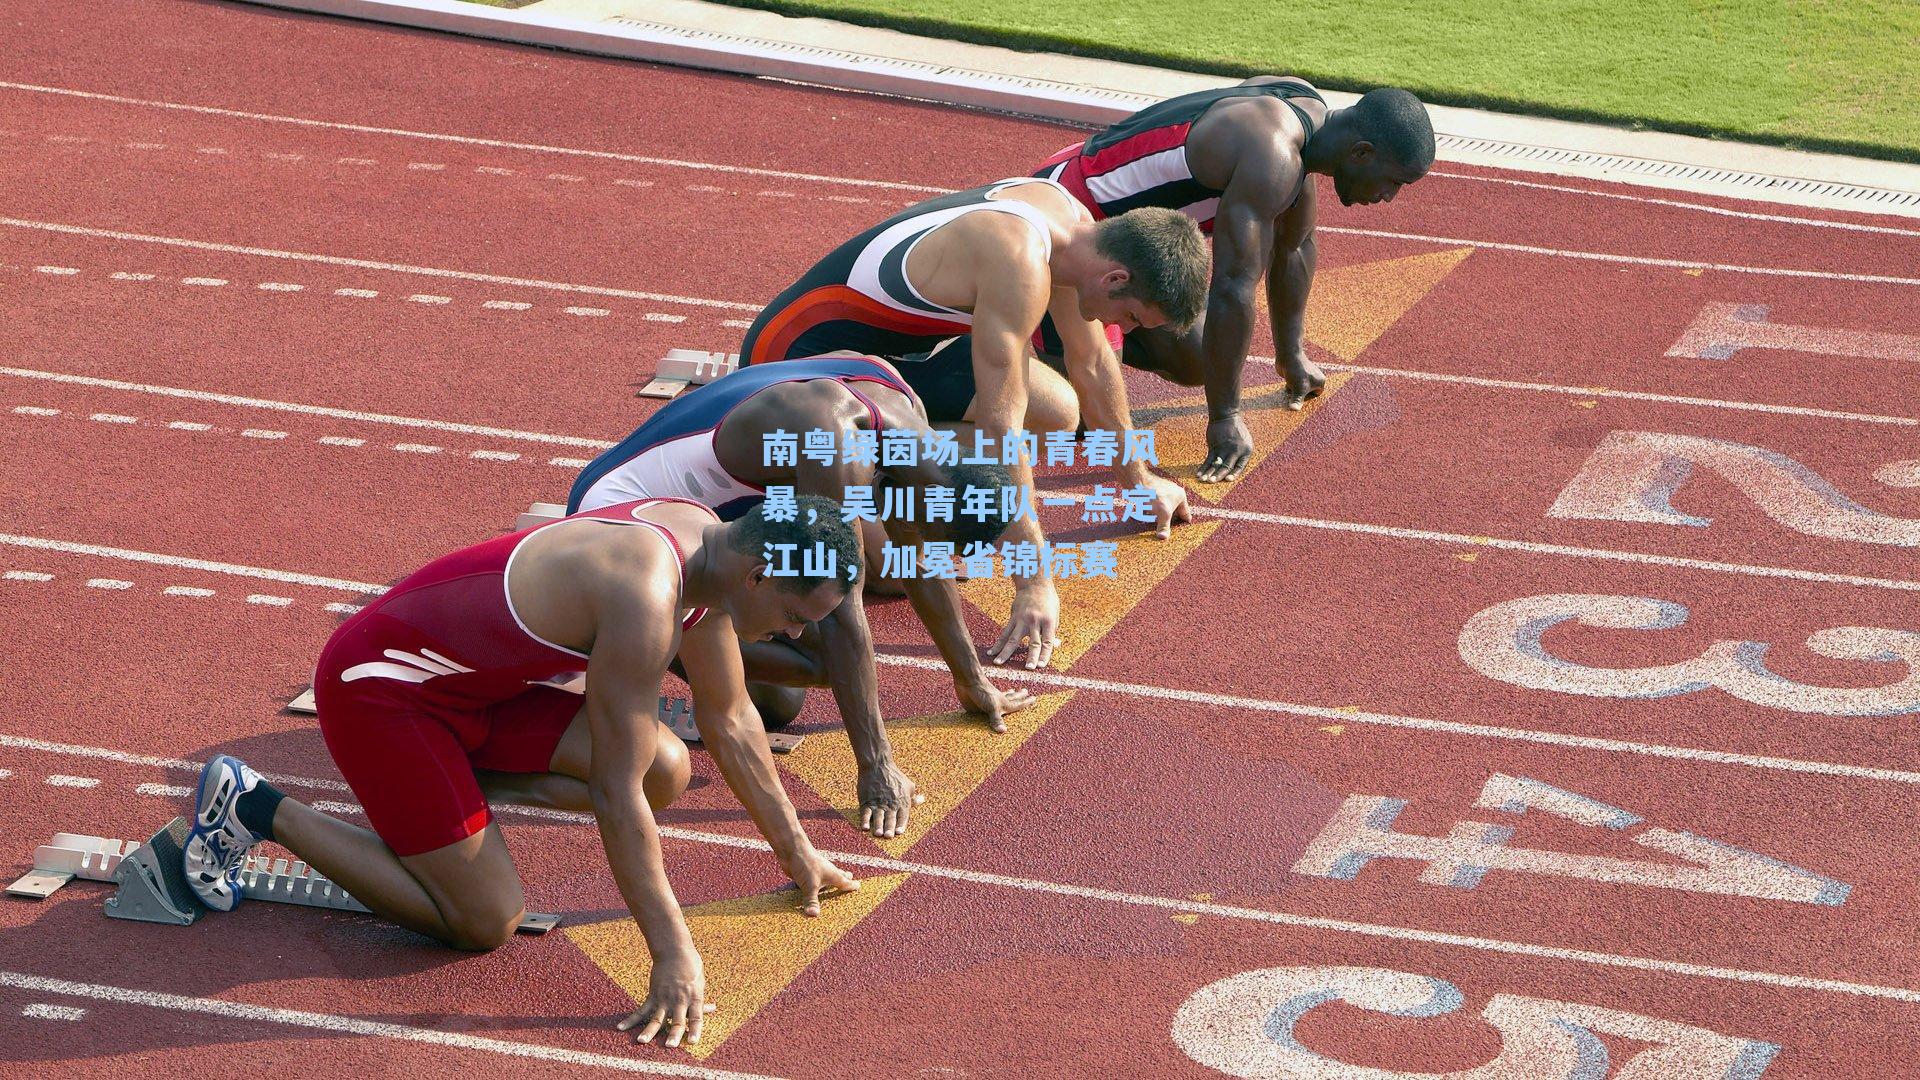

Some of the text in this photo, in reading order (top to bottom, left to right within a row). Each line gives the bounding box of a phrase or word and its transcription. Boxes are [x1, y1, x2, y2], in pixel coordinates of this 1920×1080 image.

[1546, 429, 1920, 547] 2
[1458, 593, 1920, 717] 3
[1290, 772, 1852, 907] 4
[1170, 965, 1783, 1080] 5
